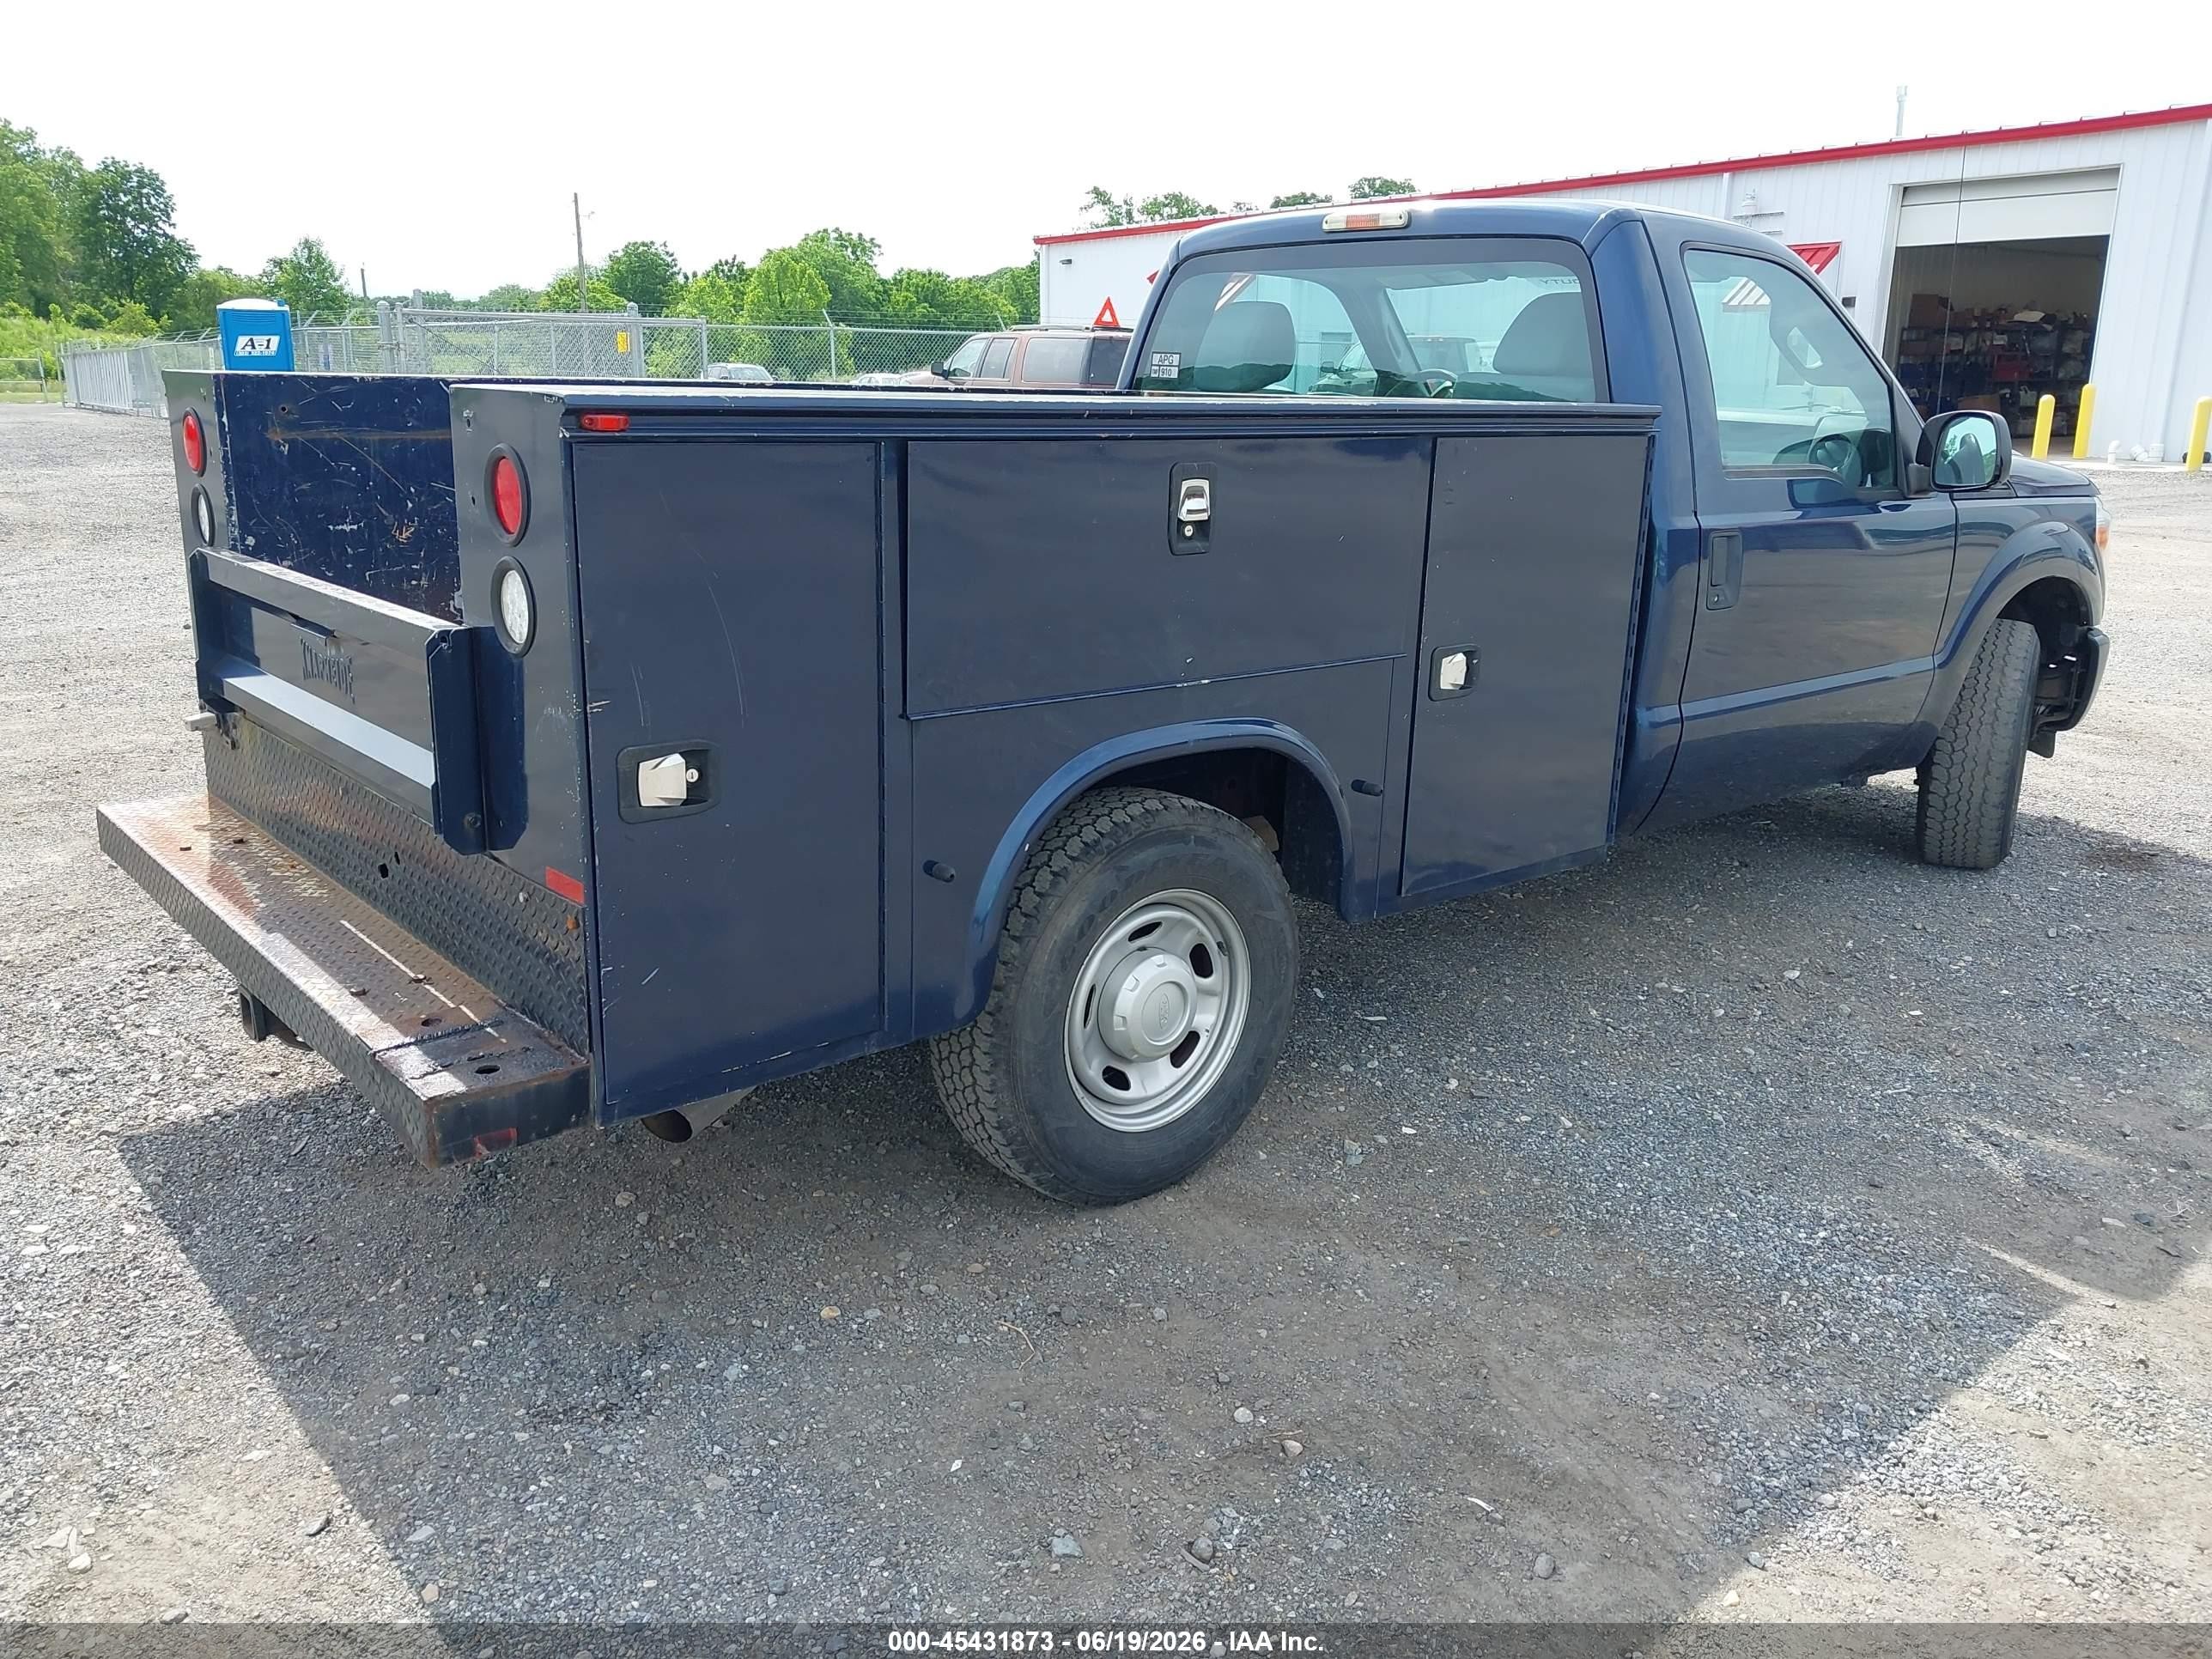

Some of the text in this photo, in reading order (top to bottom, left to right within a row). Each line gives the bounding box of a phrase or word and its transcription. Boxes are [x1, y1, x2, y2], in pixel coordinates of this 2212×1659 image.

[240, 337, 271, 349] A-1
[1158, 354, 1174, 364] APG
[1161, 368, 1172, 377] 910
